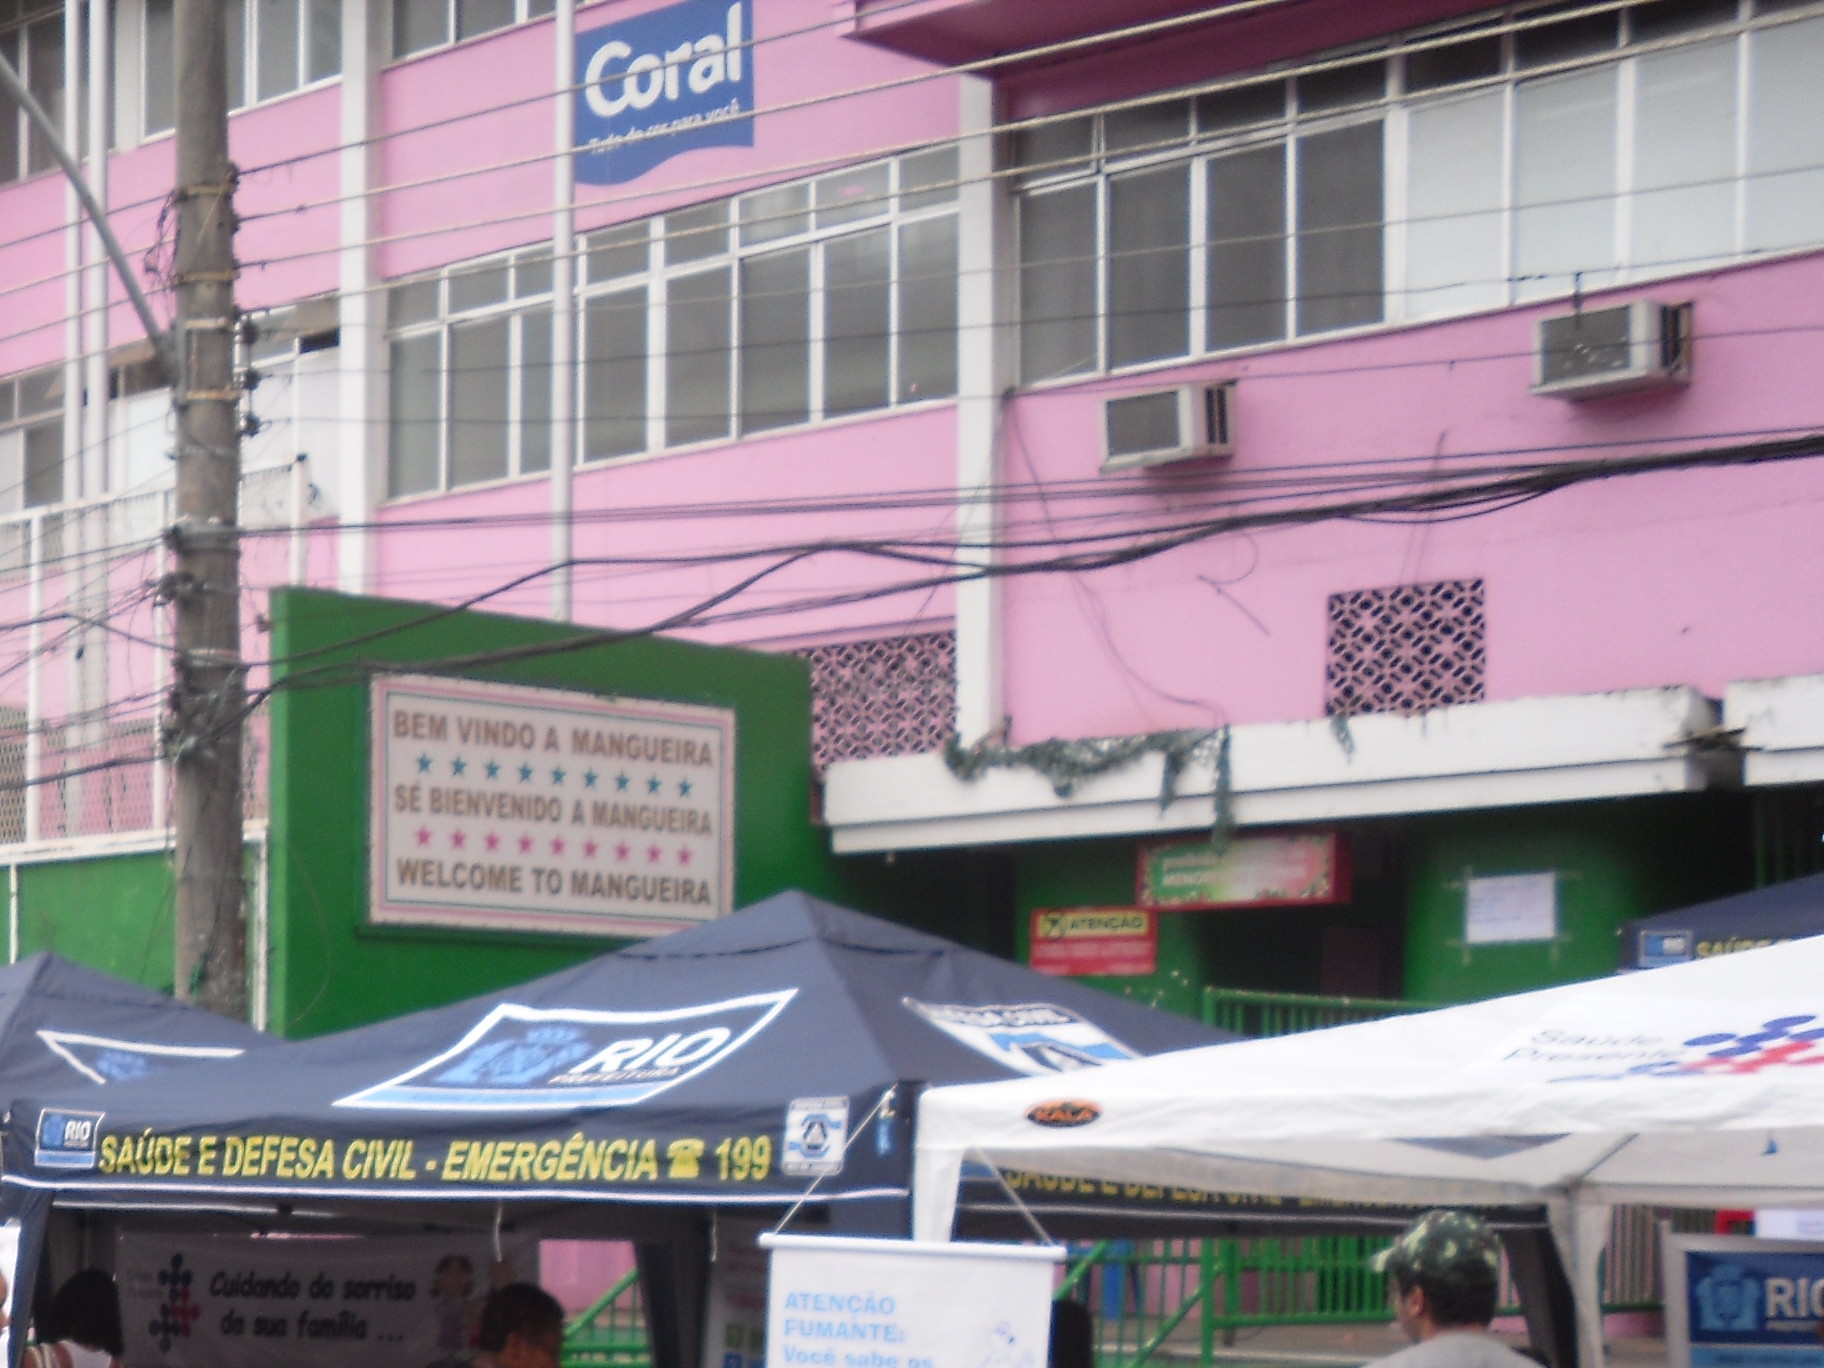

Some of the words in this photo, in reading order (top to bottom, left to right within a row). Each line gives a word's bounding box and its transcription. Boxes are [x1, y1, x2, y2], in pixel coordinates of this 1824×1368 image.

[584, 1, 743, 119] Coral
[393, 708, 448, 742] BEM
[457, 716, 536, 751] VINDO
[543, 728, 560, 753] A
[571, 729, 714, 767] MANGUEIRA
[429, 787, 562, 824] BIENVENIDO
[571, 800, 586, 826] A
[591, 800, 713, 837] MANGUEIRA
[397, 857, 523, 893] WELCOME
[530, 868, 563, 896] TO
[571, 870, 712, 907] MANGUEIRA
[567, 1026, 732, 1074] RIO
[63, 1120, 92, 1141] RIO
[98, 1128, 193, 1176] SAÚDE
[197, 1135, 218, 1175] E
[222, 1135, 335, 1180] DEFESA
[342, 1139, 417, 1181] CIVIL
[441, 1131, 658, 1182] EMERGÊNCIA
[715, 1135, 773, 1181] 199
[209, 1270, 301, 1300] Cuidando
[309, 1272, 335, 1300] do
[342, 1273, 417, 1301] sorriso
[784, 1291, 896, 1319] ATENÇÃO
[251, 1315, 289, 1338] sua
[783, 1319, 906, 1343] FUMANTE:
[783, 1344, 836, 1366] Você
